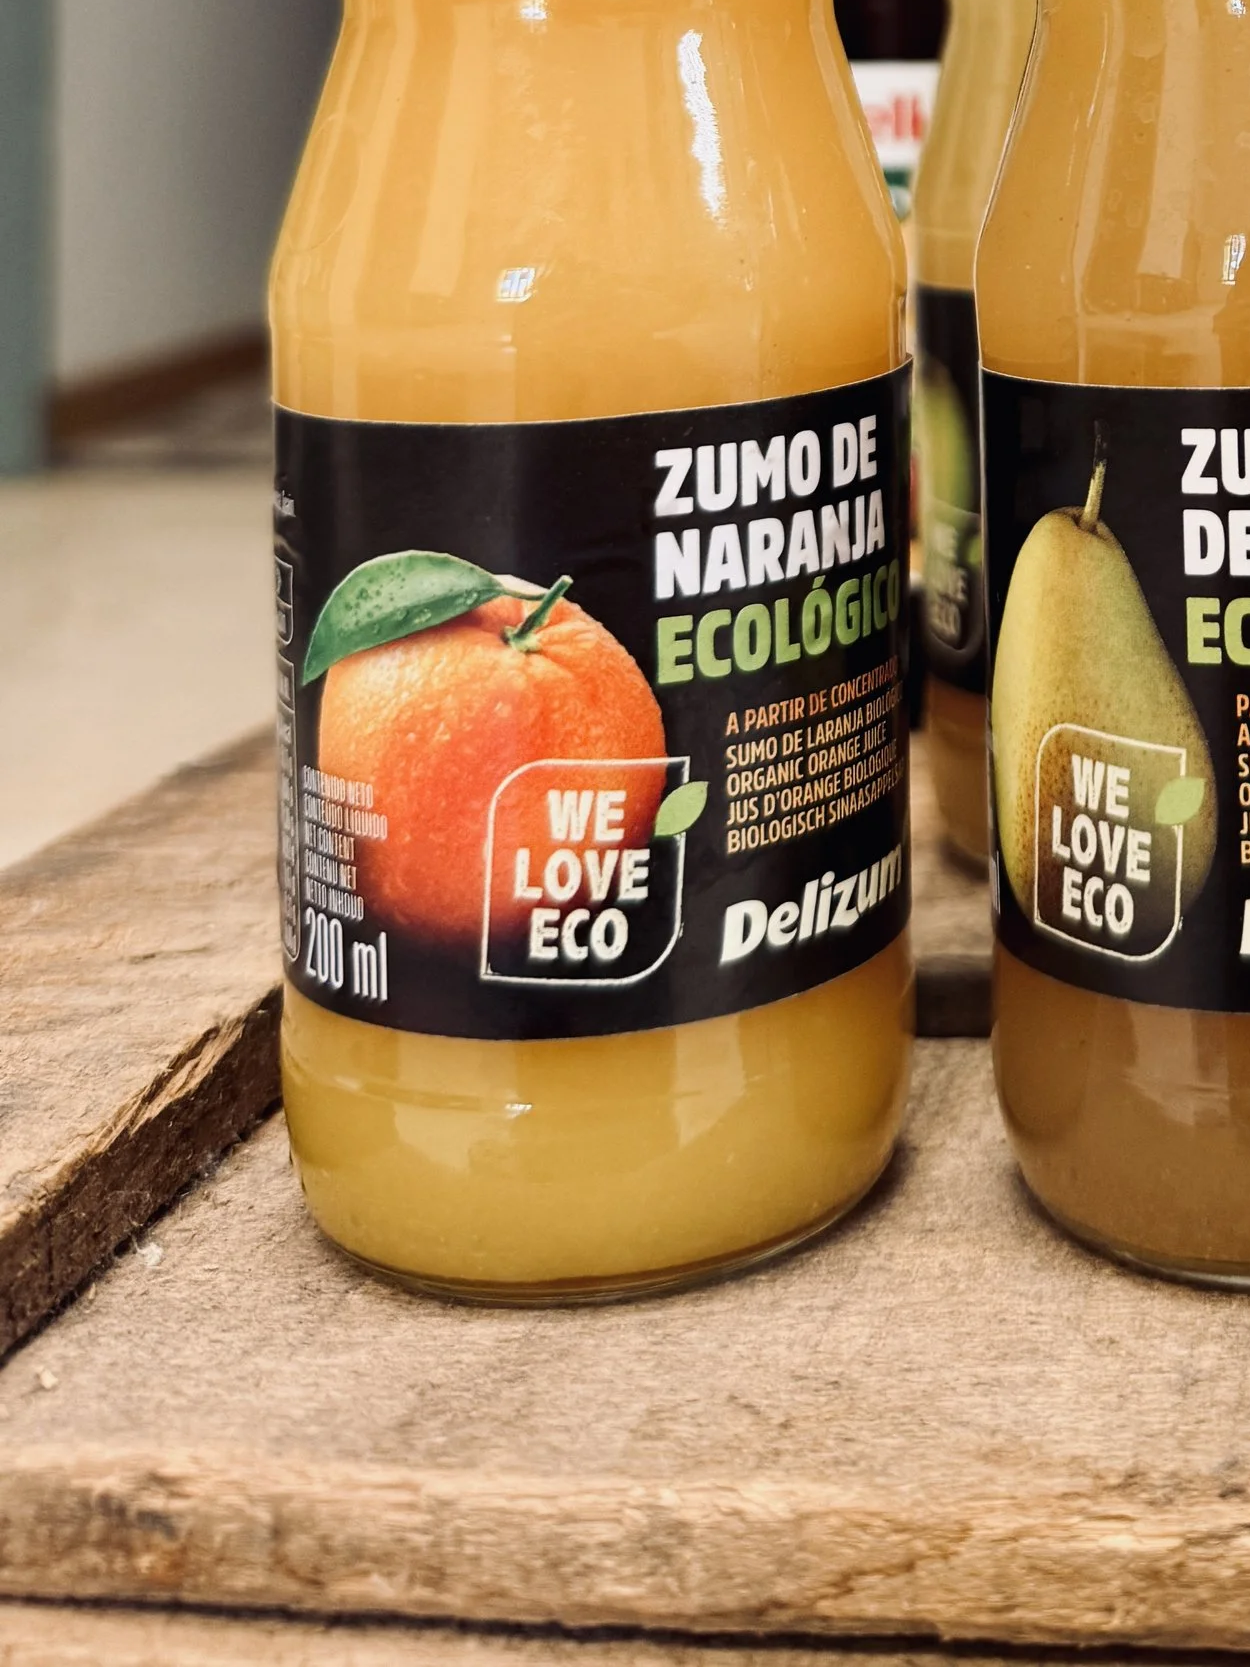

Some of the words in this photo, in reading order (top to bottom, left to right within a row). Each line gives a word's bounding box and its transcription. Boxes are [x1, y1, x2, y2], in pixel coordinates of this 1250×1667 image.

[654, 430, 821, 517] ZUMO
[832, 415, 877, 488] DE
[654, 489, 885, 600] NARANJA
[657, 559, 899, 684] ECOLÓGICO
[726, 712, 739, 736] A
[744, 697, 805, 732] PARTIR
[810, 689, 827, 716] DE
[726, 737, 777, 769] SUMO
[782, 730, 803, 756] DE
[808, 707, 863, 749] LARANJA
[1237, 723, 1250, 747] A
[727, 757, 803, 797] ORGANIC
[808, 736, 860, 775] ORANGE
[863, 721, 886, 753] JUICE
[1072, 754, 1130, 818] WE
[547, 790, 626, 842] WE
[727, 797, 758, 826] JUS
[764, 772, 840, 816] D'ORANGE
[727, 806, 825, 854] BIOLOGISCH
[513, 848, 650, 901] LOVE
[1052, 805, 1152, 883] LOVE
[720, 844, 900, 962] Delizum
[1062, 866, 1134, 935] ECO
[305, 907, 344, 988] 200
[353, 932, 387, 1001] ml
[528, 907, 628, 960] ECO
